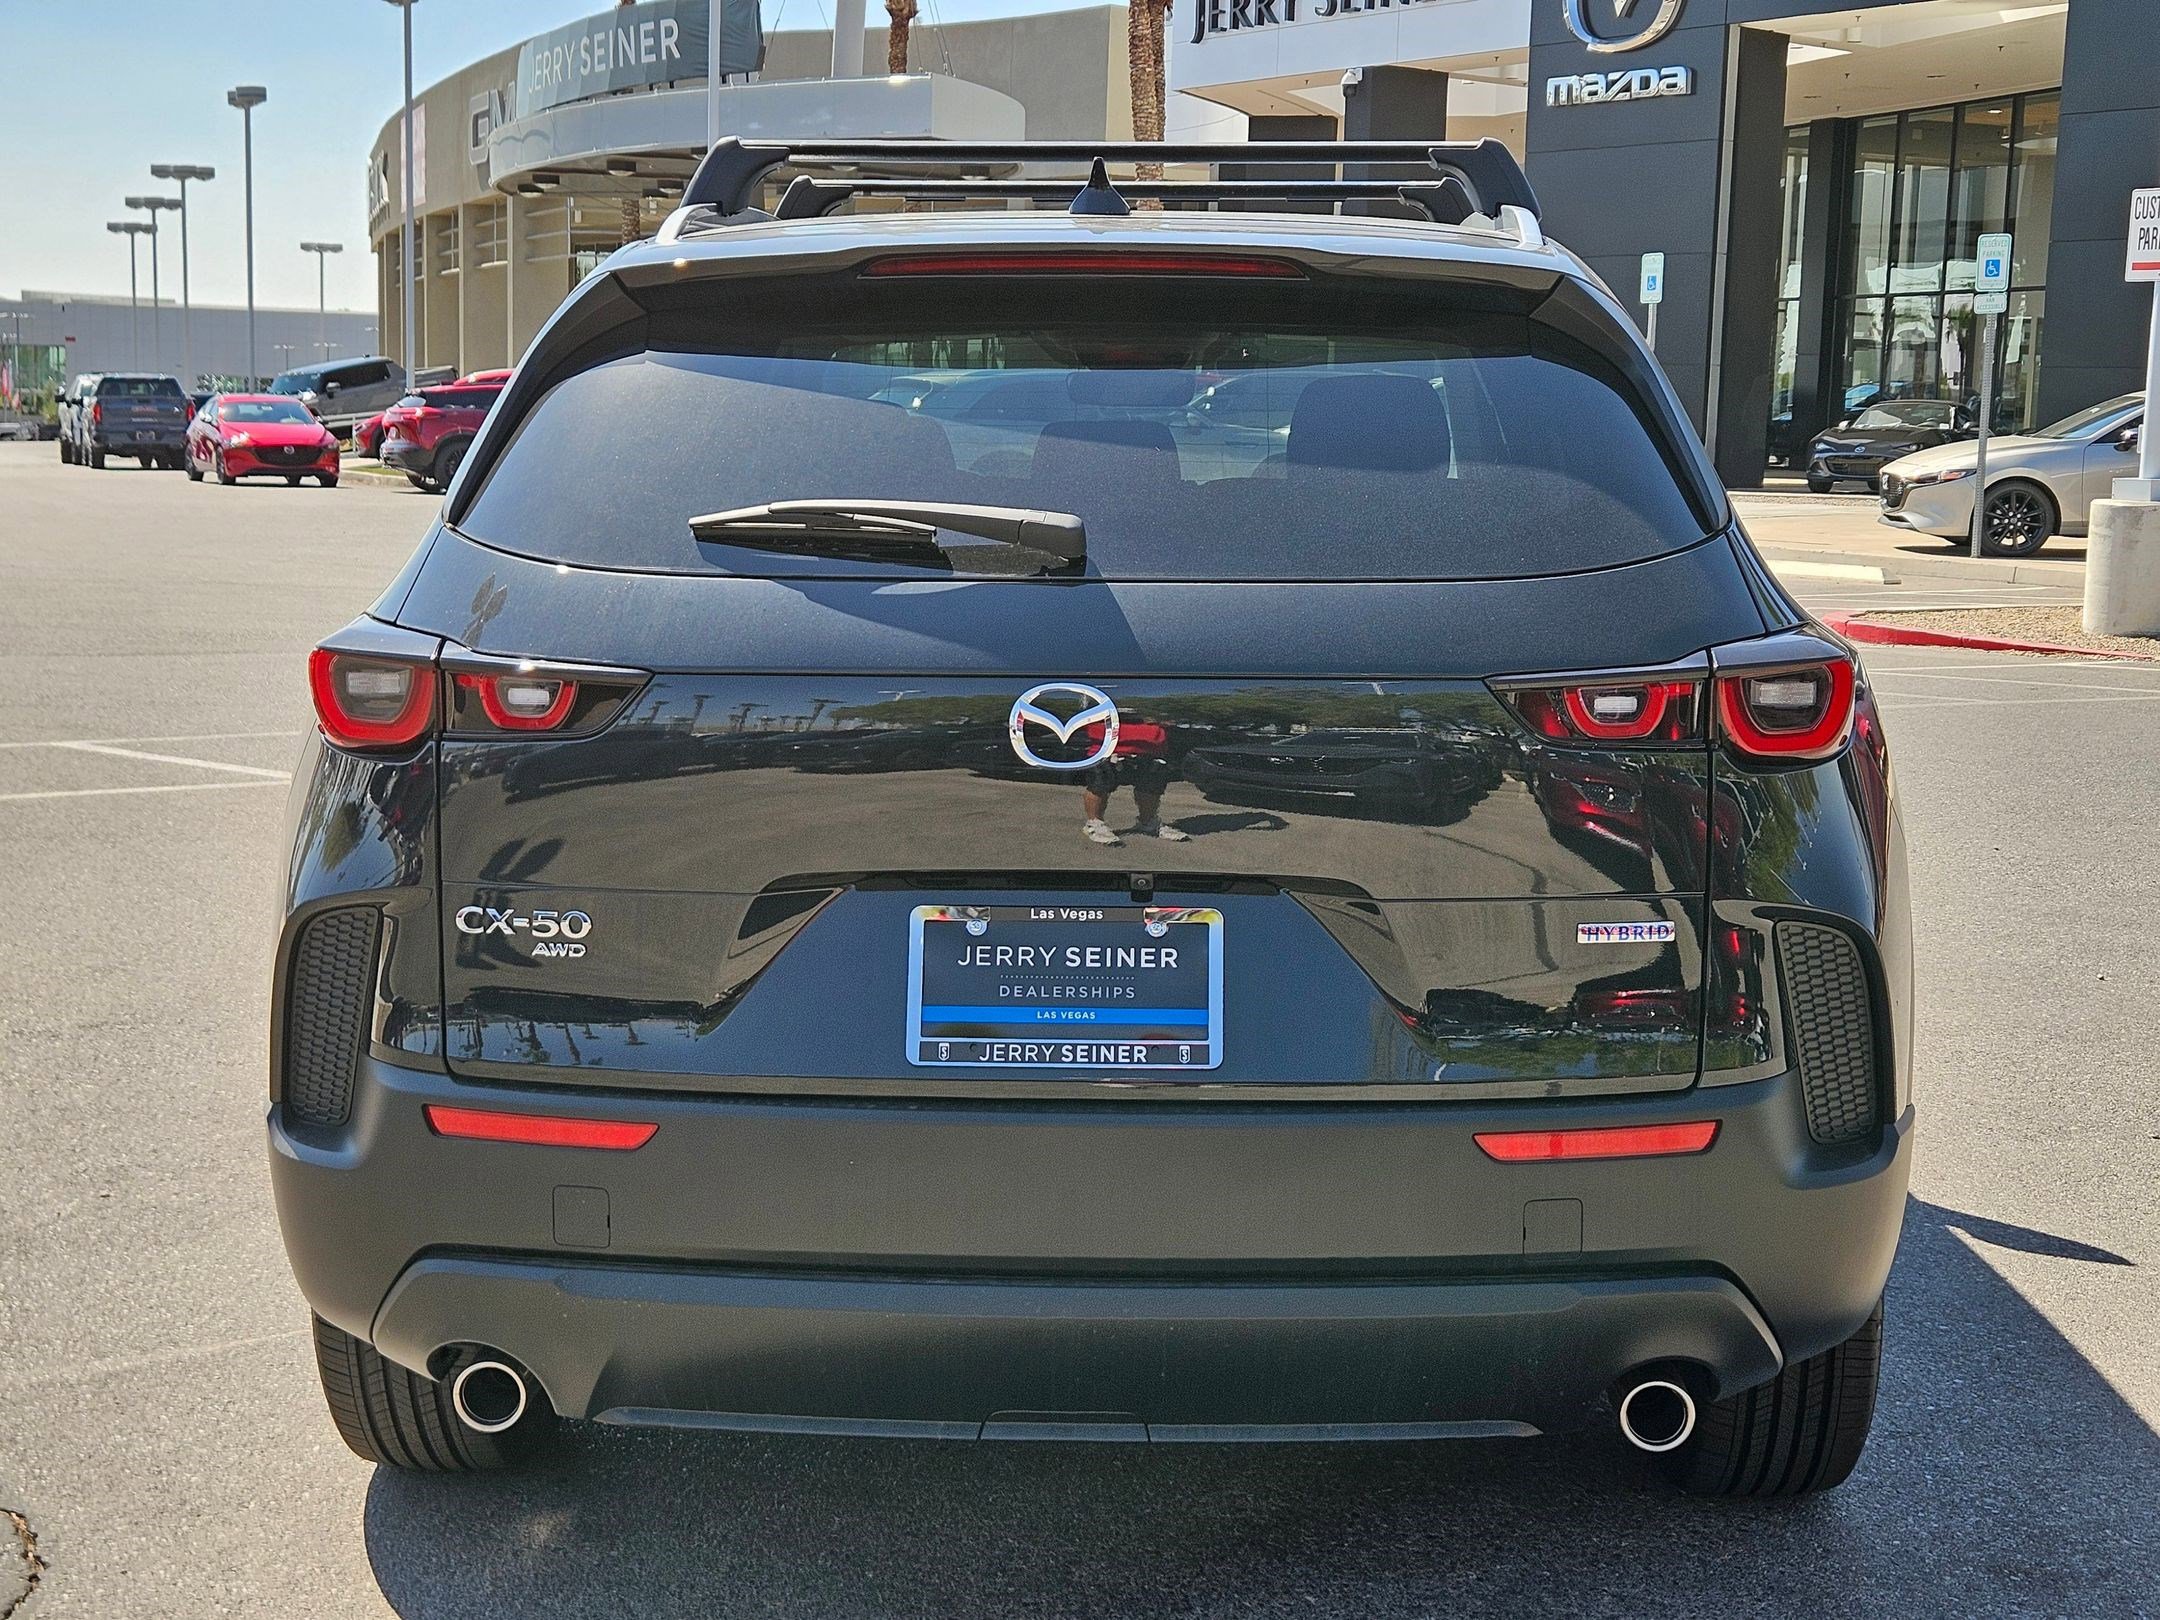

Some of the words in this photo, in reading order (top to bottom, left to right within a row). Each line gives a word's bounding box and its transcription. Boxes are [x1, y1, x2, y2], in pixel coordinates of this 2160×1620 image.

[528, 40, 576, 94] JERRY
[580, 18, 681, 76] SEINER
[2137, 226, 2160, 251] PAR
[455, 905, 593, 939] CX-50
[1030, 908, 1055, 920] Las
[1060, 908, 1104, 921] Vegas
[1586, 924, 1670, 942] HYBRID
[531, 942, 587, 958] AWD
[957, 945, 1058, 967] JERRY
[1065, 946, 1179, 969] SEINER
[999, 985, 1136, 999] DEALERSHIPS
[1037, 1010, 1057, 1019] LAS
[1060, 1011, 1096, 1020] VEGAS
[978, 1043, 1057, 1062] JERRY
[1061, 1045, 1148, 1064] SEINER
